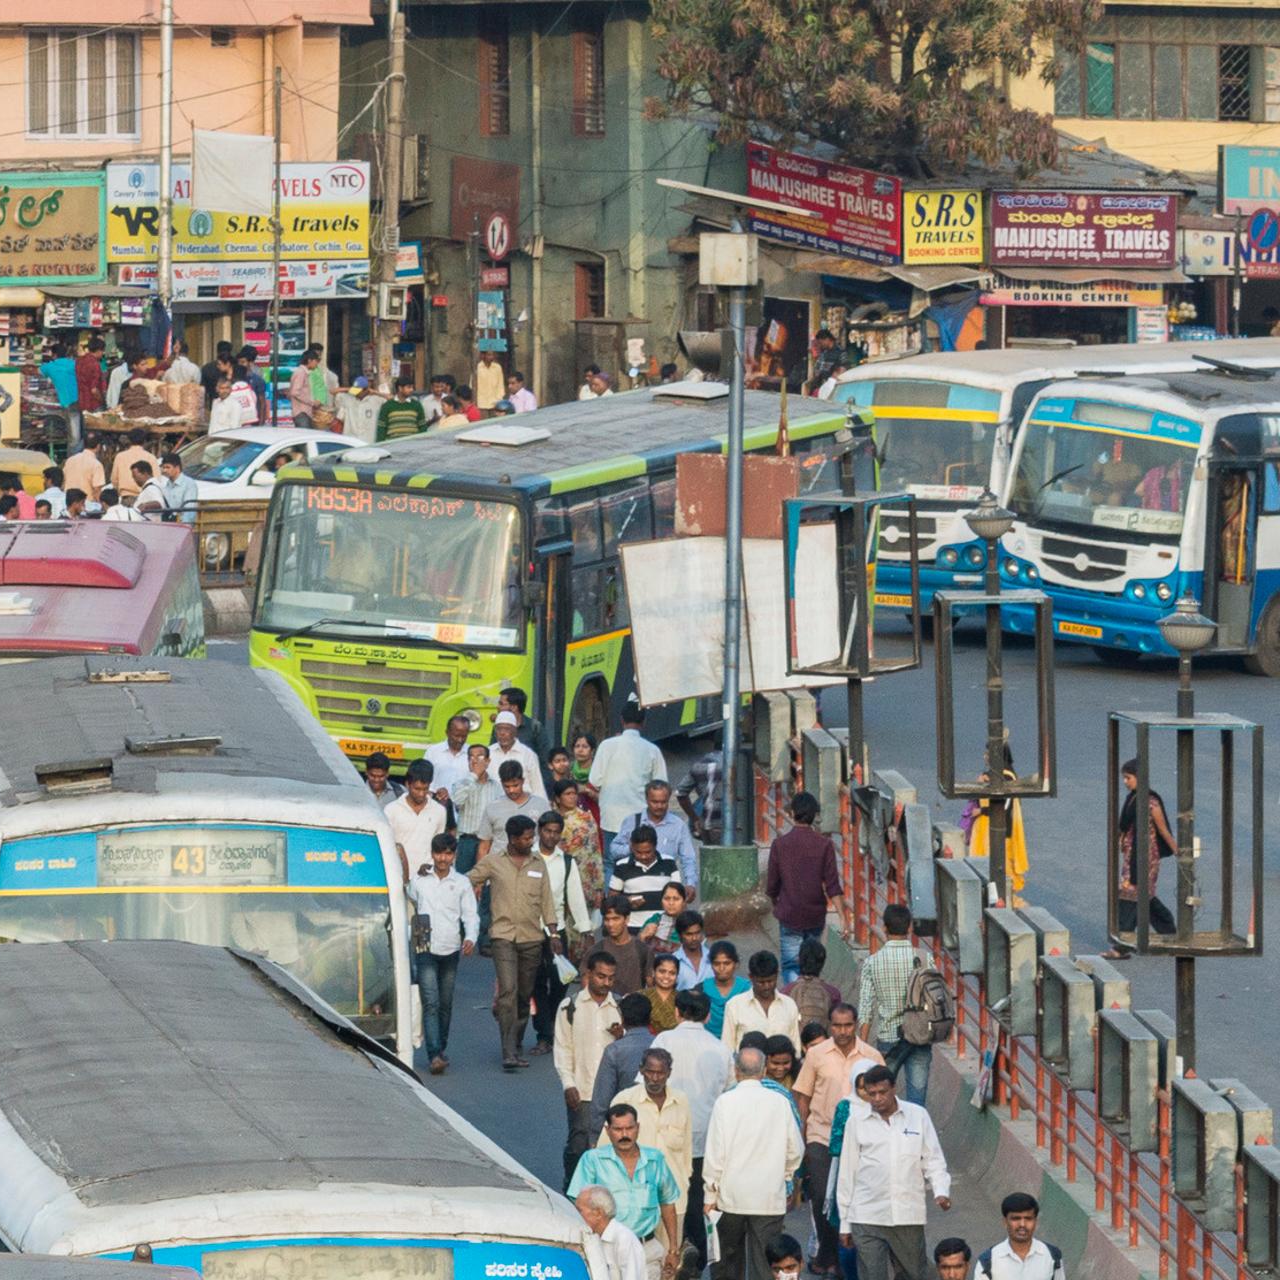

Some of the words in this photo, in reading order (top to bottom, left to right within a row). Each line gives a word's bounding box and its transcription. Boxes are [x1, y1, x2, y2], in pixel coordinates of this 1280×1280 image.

[331, 174, 358, 189] NTC
[751, 169, 835, 208] MANJUSHREE
[839, 191, 895, 222] TRAVELS
[912, 194, 978, 228] S.R.S
[292, 215, 359, 232] travels
[1008, 212, 1084, 227] ಮಂಜುಶ್ರೀ
[915, 230, 975, 244] TRAVELS
[994, 228, 1095, 248] MANJUSHREE
[1106, 230, 1169, 250] TRAVELS
[908, 247, 945, 257] BOOKING
[947, 247, 979, 256] CENTER
[19, 265, 28, 276] &
[1014, 292, 1072, 302] BOOKING
[1082, 293, 1129, 302] CENTRE
[172, 846, 204, 874] 43
[485, 1262, 527, 1277] ಪರಿಸರ
